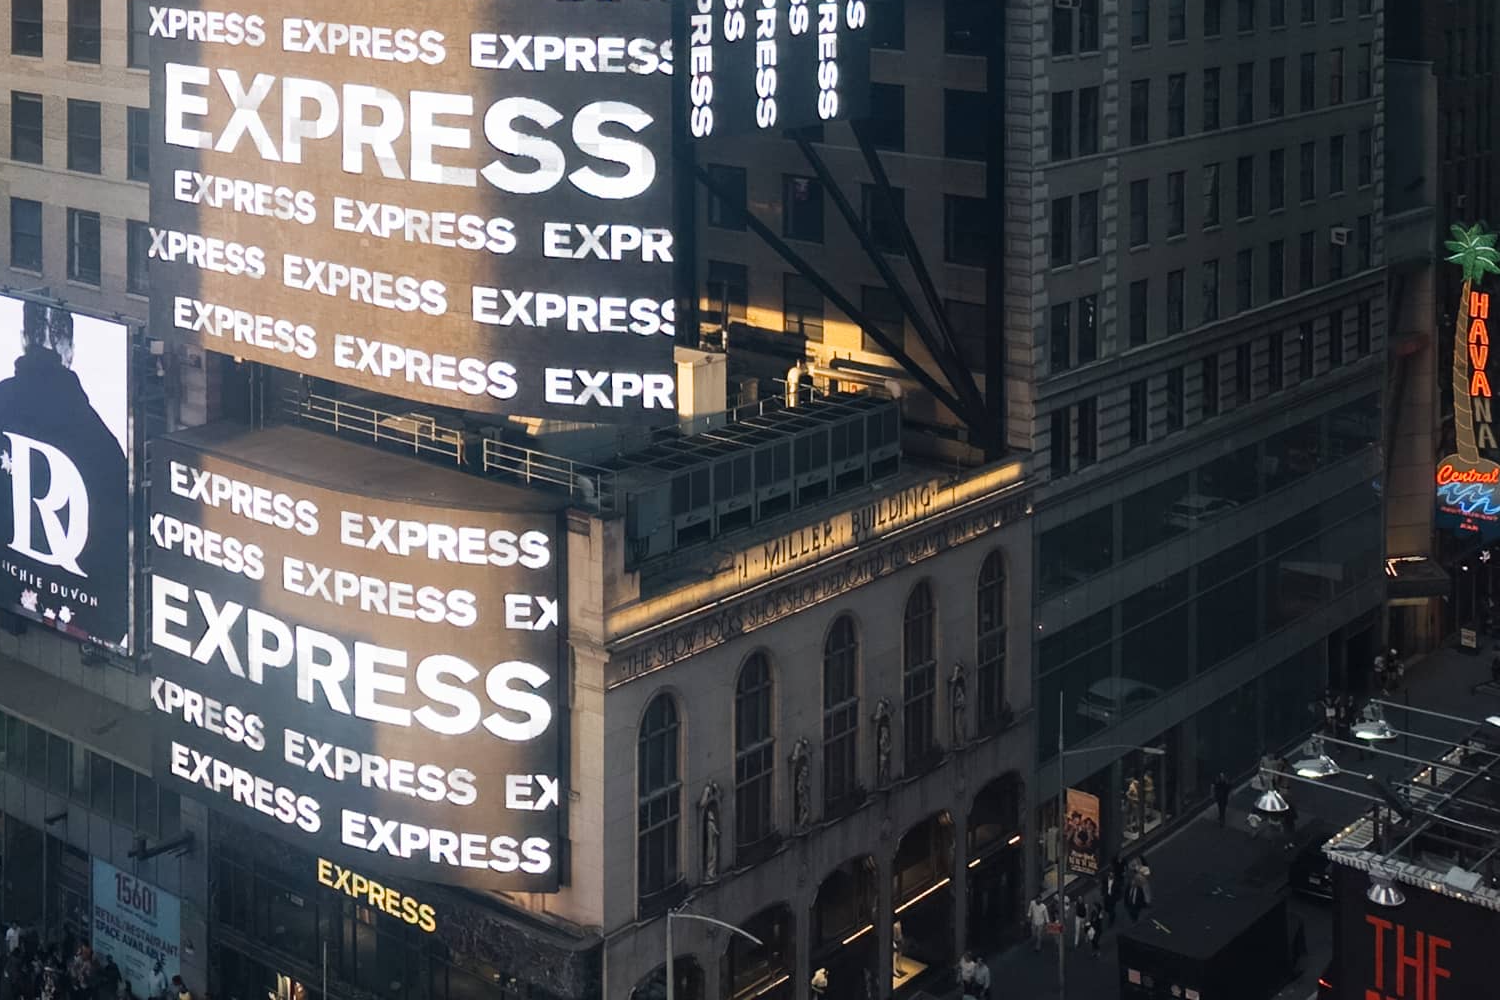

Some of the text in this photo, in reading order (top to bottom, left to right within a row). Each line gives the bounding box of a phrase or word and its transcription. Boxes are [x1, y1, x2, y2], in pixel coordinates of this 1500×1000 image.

[283, 18, 446, 64] EXPRESS
[164, 62, 657, 200] EXPRESS
[174, 169, 673, 262] EXPRESS EXPRESS EXPR
[283, 254, 447, 316] EXPRESS
[174, 296, 674, 409] EXPRESS EXPRESS EXPR
[1468, 291, 1498, 449] HAVANA
[170, 461, 550, 569] EXPRESS EXPRESS
[1437, 465, 1499, 485] Central
[764, 524, 835, 570] MILLER
[851, 488, 931, 537] BUILDING
[283, 556, 477, 627] EXPRESS
[151, 574, 552, 742] EXPRESS
[627, 647, 653, 675] THE
[657, 630, 695, 664] SHOW
[749, 594, 782, 625] SHOE
[171, 741, 552, 874] EXPRESS EXPRESS
[284, 729, 477, 806] EXPRESS
[95, 920, 121, 942] SPACE
[116, 873, 152, 916] 1560
[317, 857, 437, 933] EXPRESS
[1364, 913, 1453, 1000] THE
